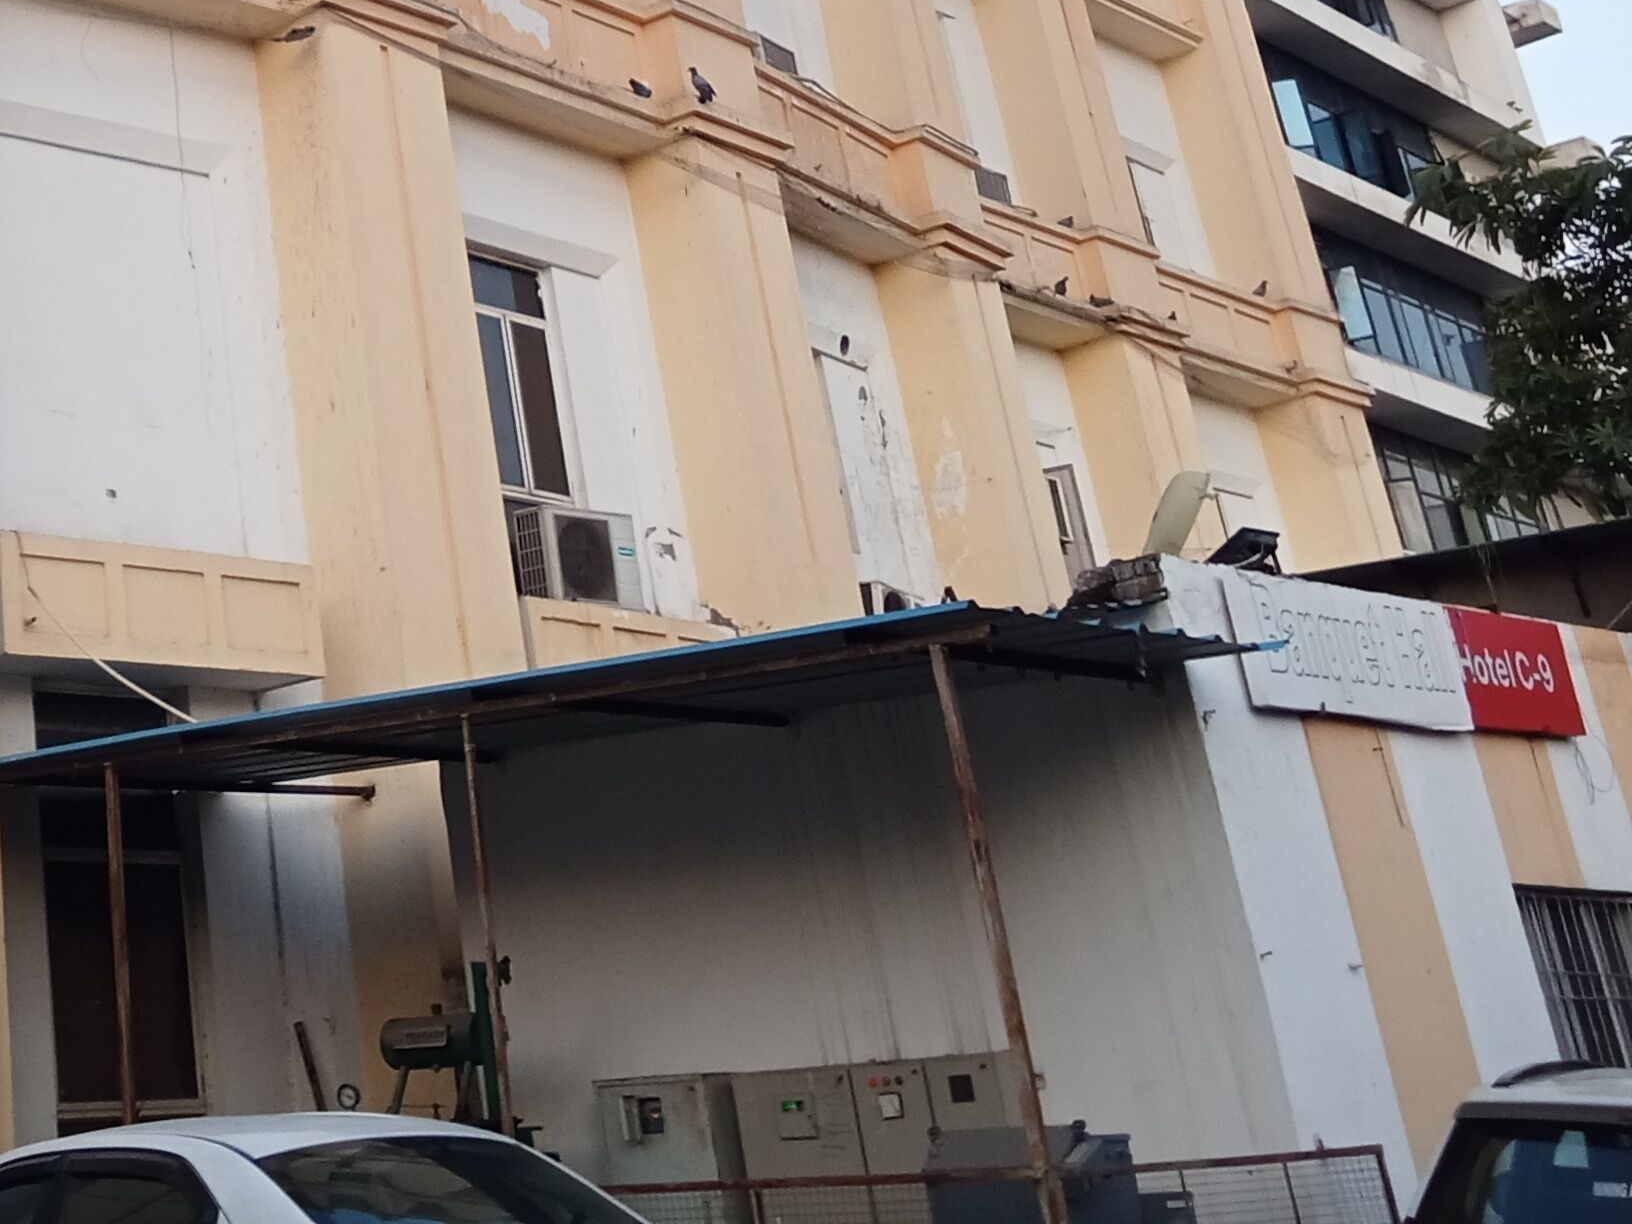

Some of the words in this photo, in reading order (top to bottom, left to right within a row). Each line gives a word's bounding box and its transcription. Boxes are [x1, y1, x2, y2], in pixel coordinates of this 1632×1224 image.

[1381, 604, 1457, 693] Hall
[1459, 643, 1517, 688] Hotel
[1515, 650, 1554, 693] C-9
